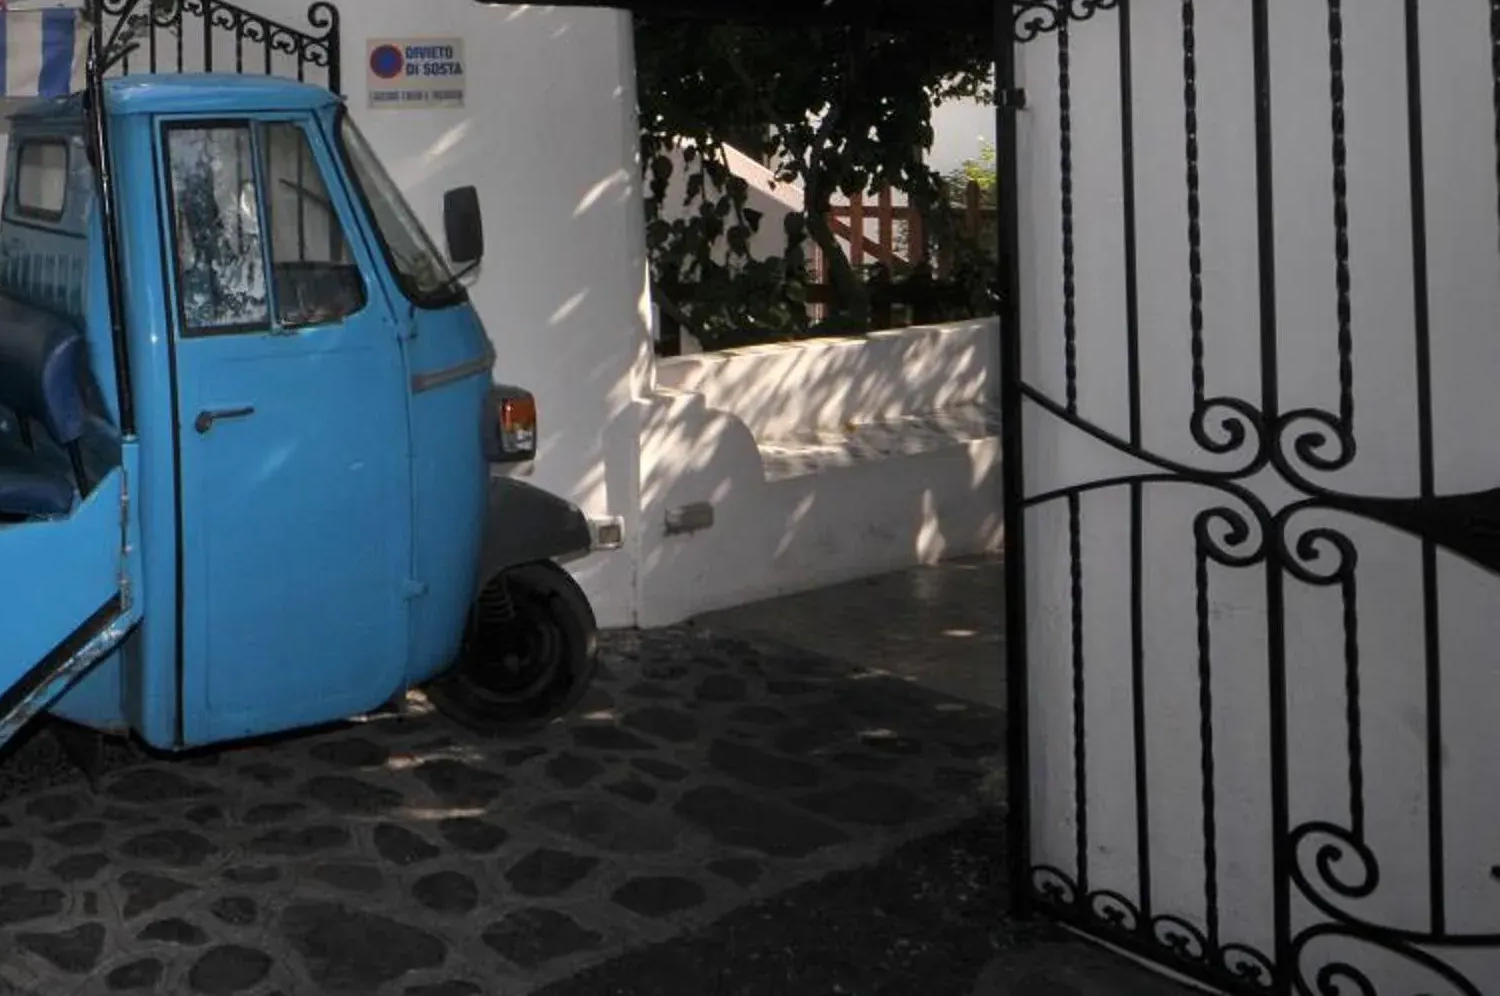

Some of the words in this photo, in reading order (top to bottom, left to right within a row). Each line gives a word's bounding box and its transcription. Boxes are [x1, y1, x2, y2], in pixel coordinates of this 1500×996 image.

[405, 45, 454, 60] DIVIETO
[405, 62, 419, 77] DI
[423, 62, 463, 77] SOSTA
